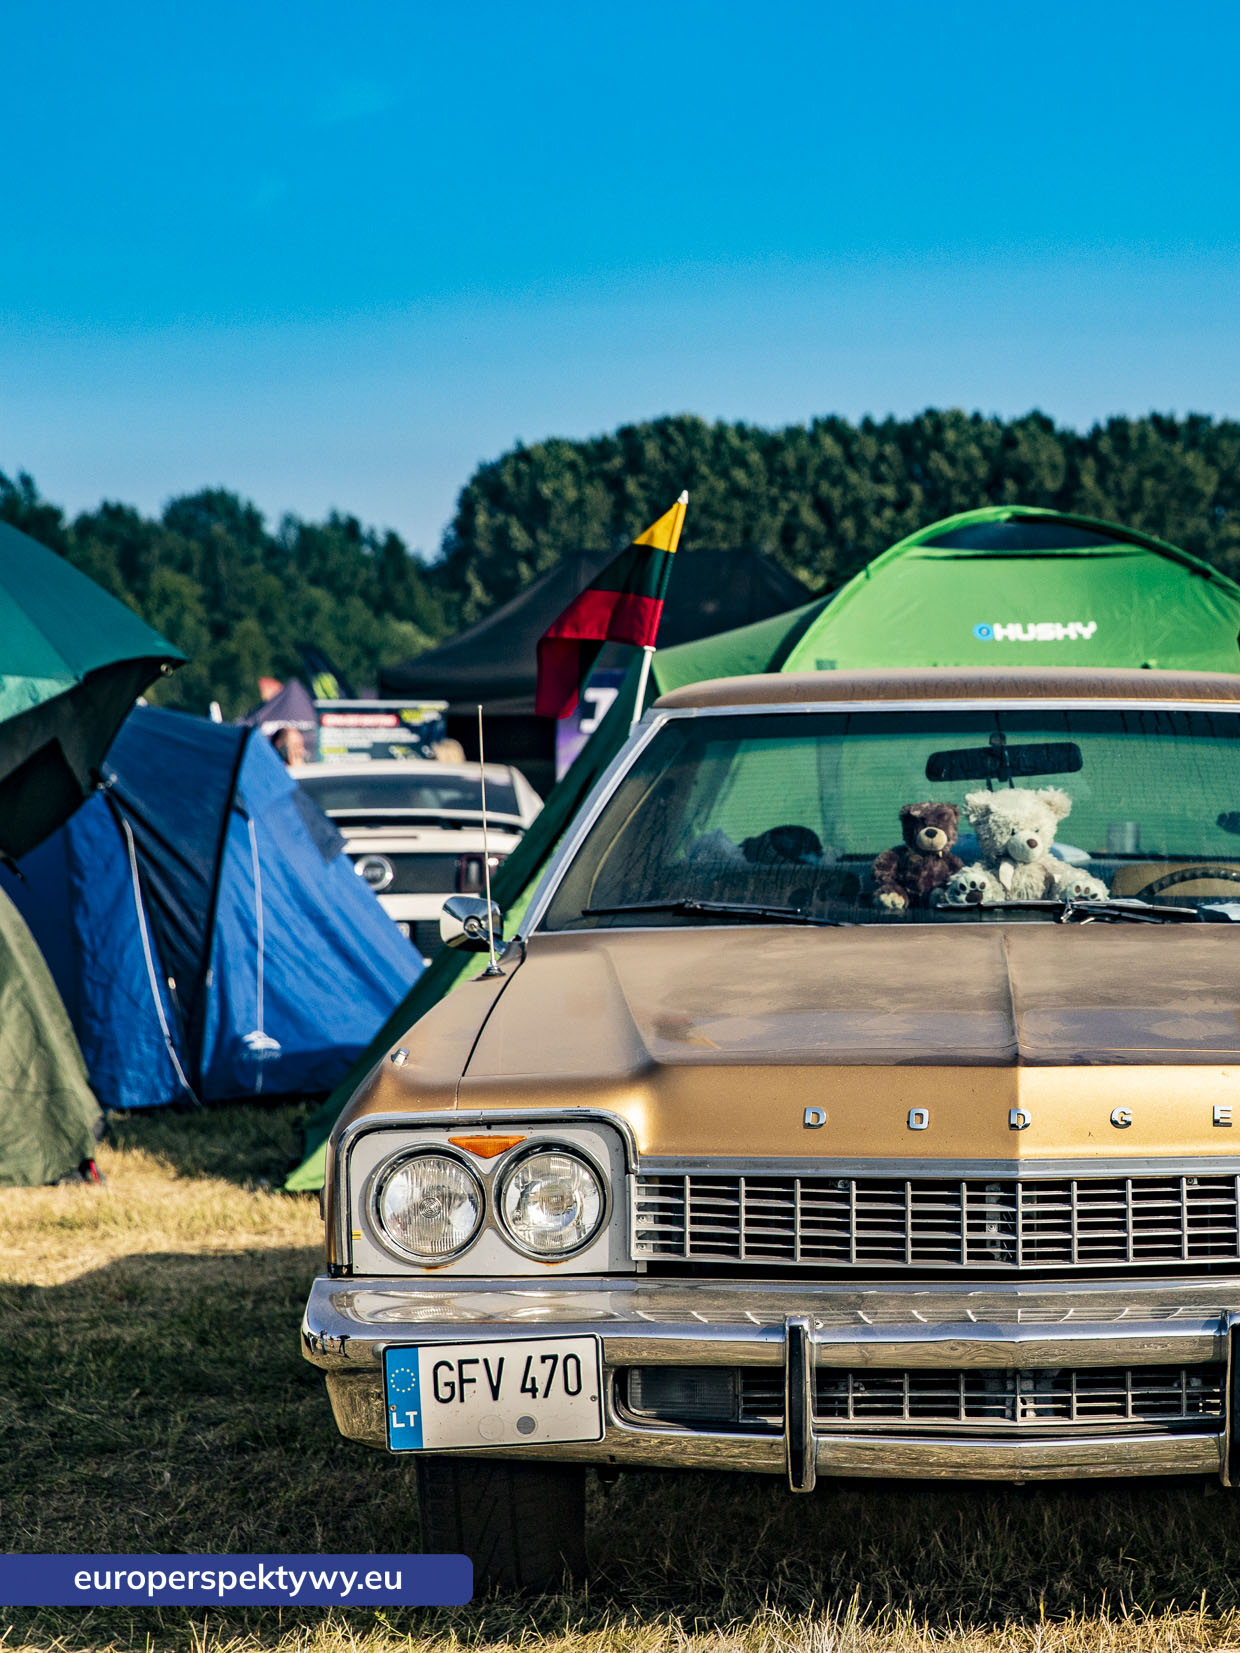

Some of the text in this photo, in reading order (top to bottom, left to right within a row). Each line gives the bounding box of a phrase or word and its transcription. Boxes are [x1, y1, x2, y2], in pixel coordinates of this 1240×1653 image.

[803, 1106, 1233, 1131] DODGE
[432, 1352, 583, 1404] GFV 470
[392, 1410, 419, 1429] LT
